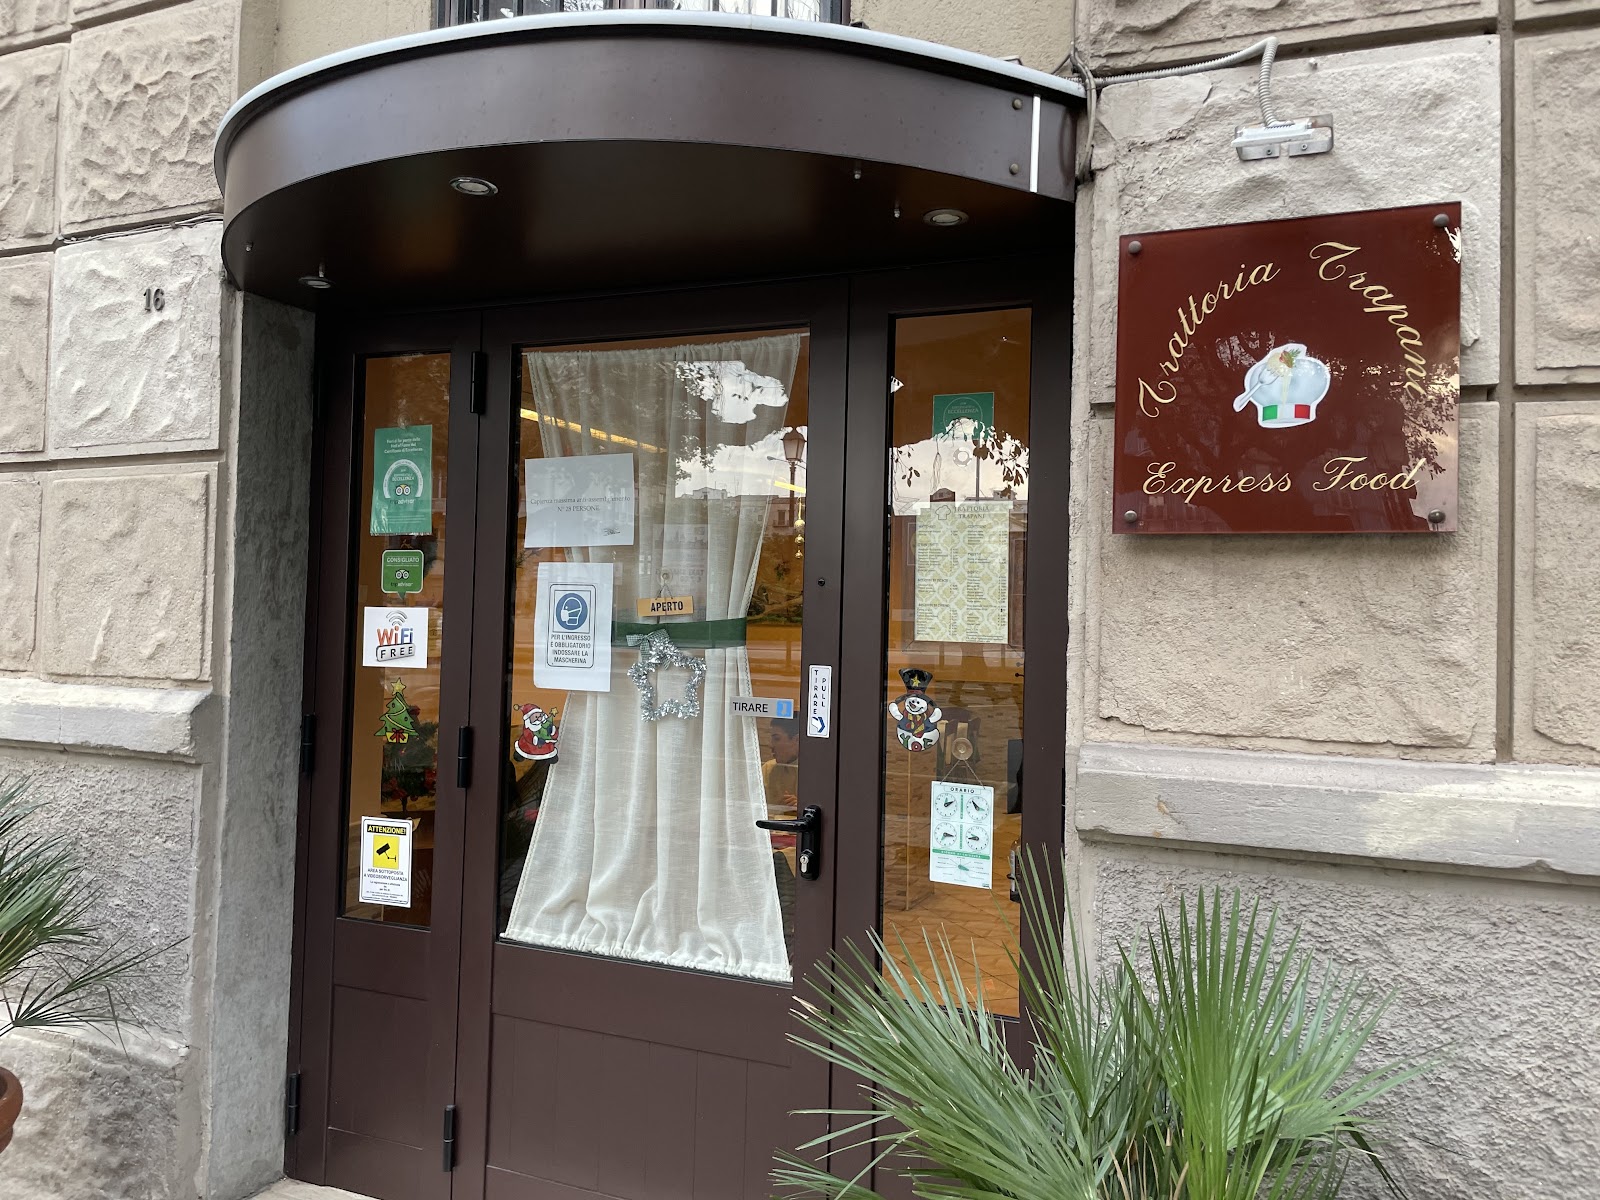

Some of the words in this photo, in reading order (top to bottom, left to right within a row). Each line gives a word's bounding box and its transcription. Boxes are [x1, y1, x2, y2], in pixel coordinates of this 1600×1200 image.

[143, 288, 165, 311] 16
[1137, 262, 1281, 418] Trattoria
[1142, 462, 1292, 504] Express
[1313, 456, 1427, 493] Food
[650, 600, 684, 612] APERTO
[380, 646, 413, 659] FREE
[732, 701, 769, 713] TIRARE
[950, 786, 975, 794] ORARIO
[367, 825, 406, 835] ATTENZIONE!
